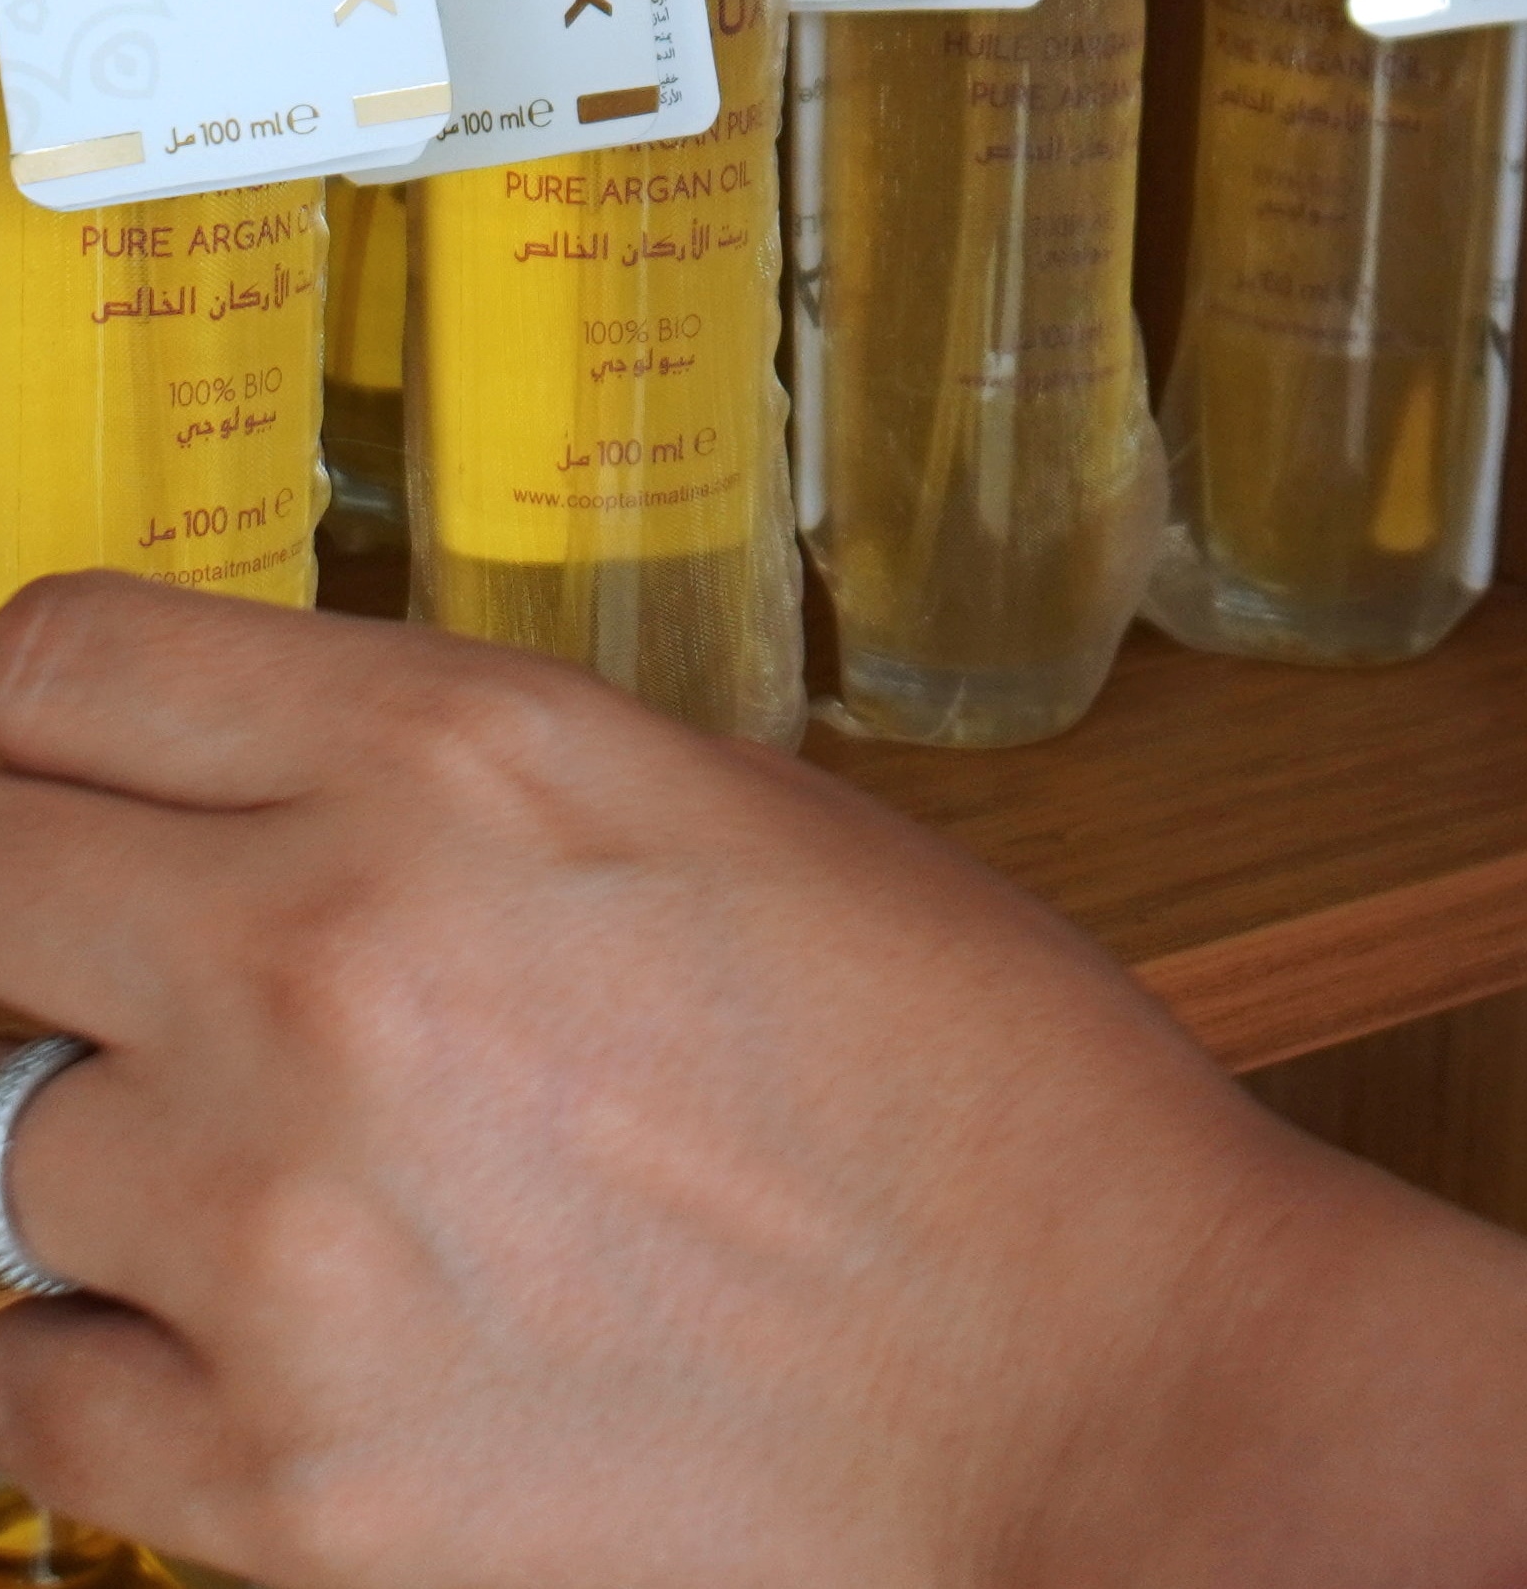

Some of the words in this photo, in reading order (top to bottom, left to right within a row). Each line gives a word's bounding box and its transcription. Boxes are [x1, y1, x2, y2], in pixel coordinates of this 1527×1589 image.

[198, 118, 242, 147] 100
[249, 110, 285, 140] ml
[461, 109, 493, 136] 100
[499, 104, 526, 131] ml
[506, 170, 586, 206] PURE
[600, 171, 711, 208] ARGAN
[720, 162, 751, 193] OIL
[81, 225, 173, 258] PURE
[187, 215, 292, 256] ARGAN
[92, 285, 197, 324] الخالص
[584, 319, 650, 345] 100%
[658, 314, 702, 342] BIO
[169, 376, 236, 407] 100%
[243, 367, 282, 397] BIO
[177, 404, 277, 449] بيولوجي
[598, 438, 643, 466] 100
[652, 436, 684, 463] ml
[183, 507, 228, 538] 100
[236, 499, 266, 530] ml
